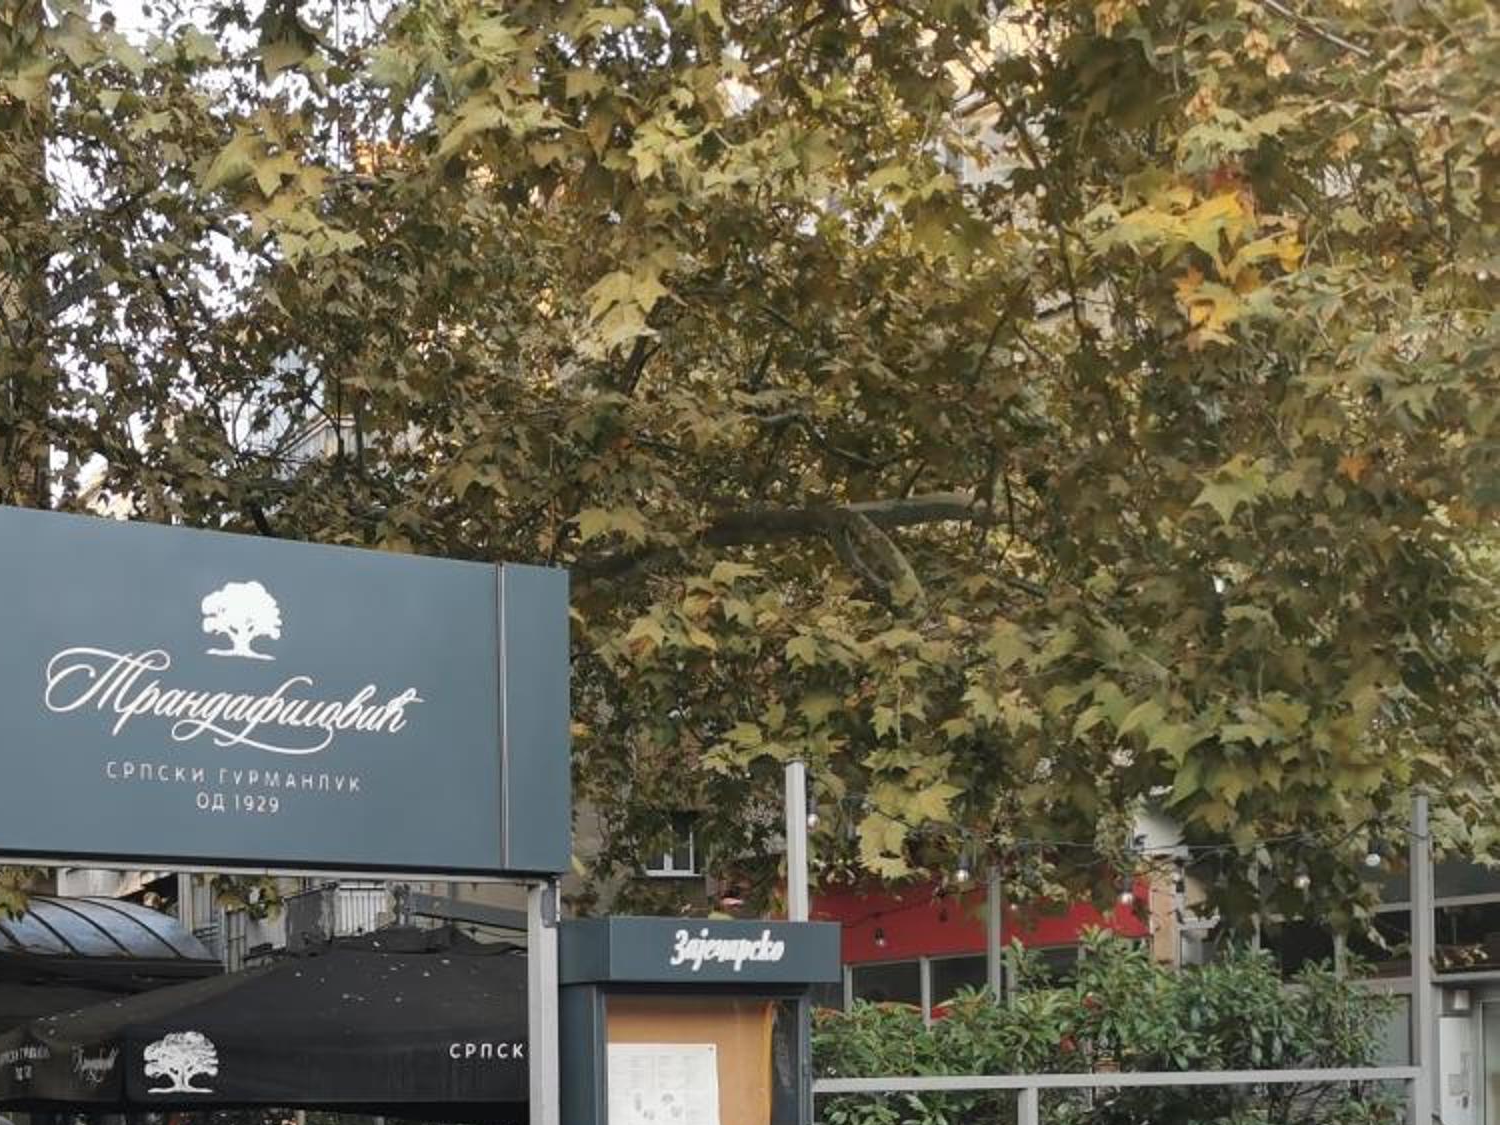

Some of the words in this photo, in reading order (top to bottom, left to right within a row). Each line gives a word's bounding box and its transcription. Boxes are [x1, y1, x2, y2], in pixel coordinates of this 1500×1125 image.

[45, 646, 424, 755] Трандафиловић
[106, 761, 205, 783] СРПСКИ
[219, 767, 361, 792] ГУРМАНЛУК
[196, 791, 226, 813] ОД
[235, 794, 280, 813] 1929
[449, 1042, 525, 1060] СРПСК
